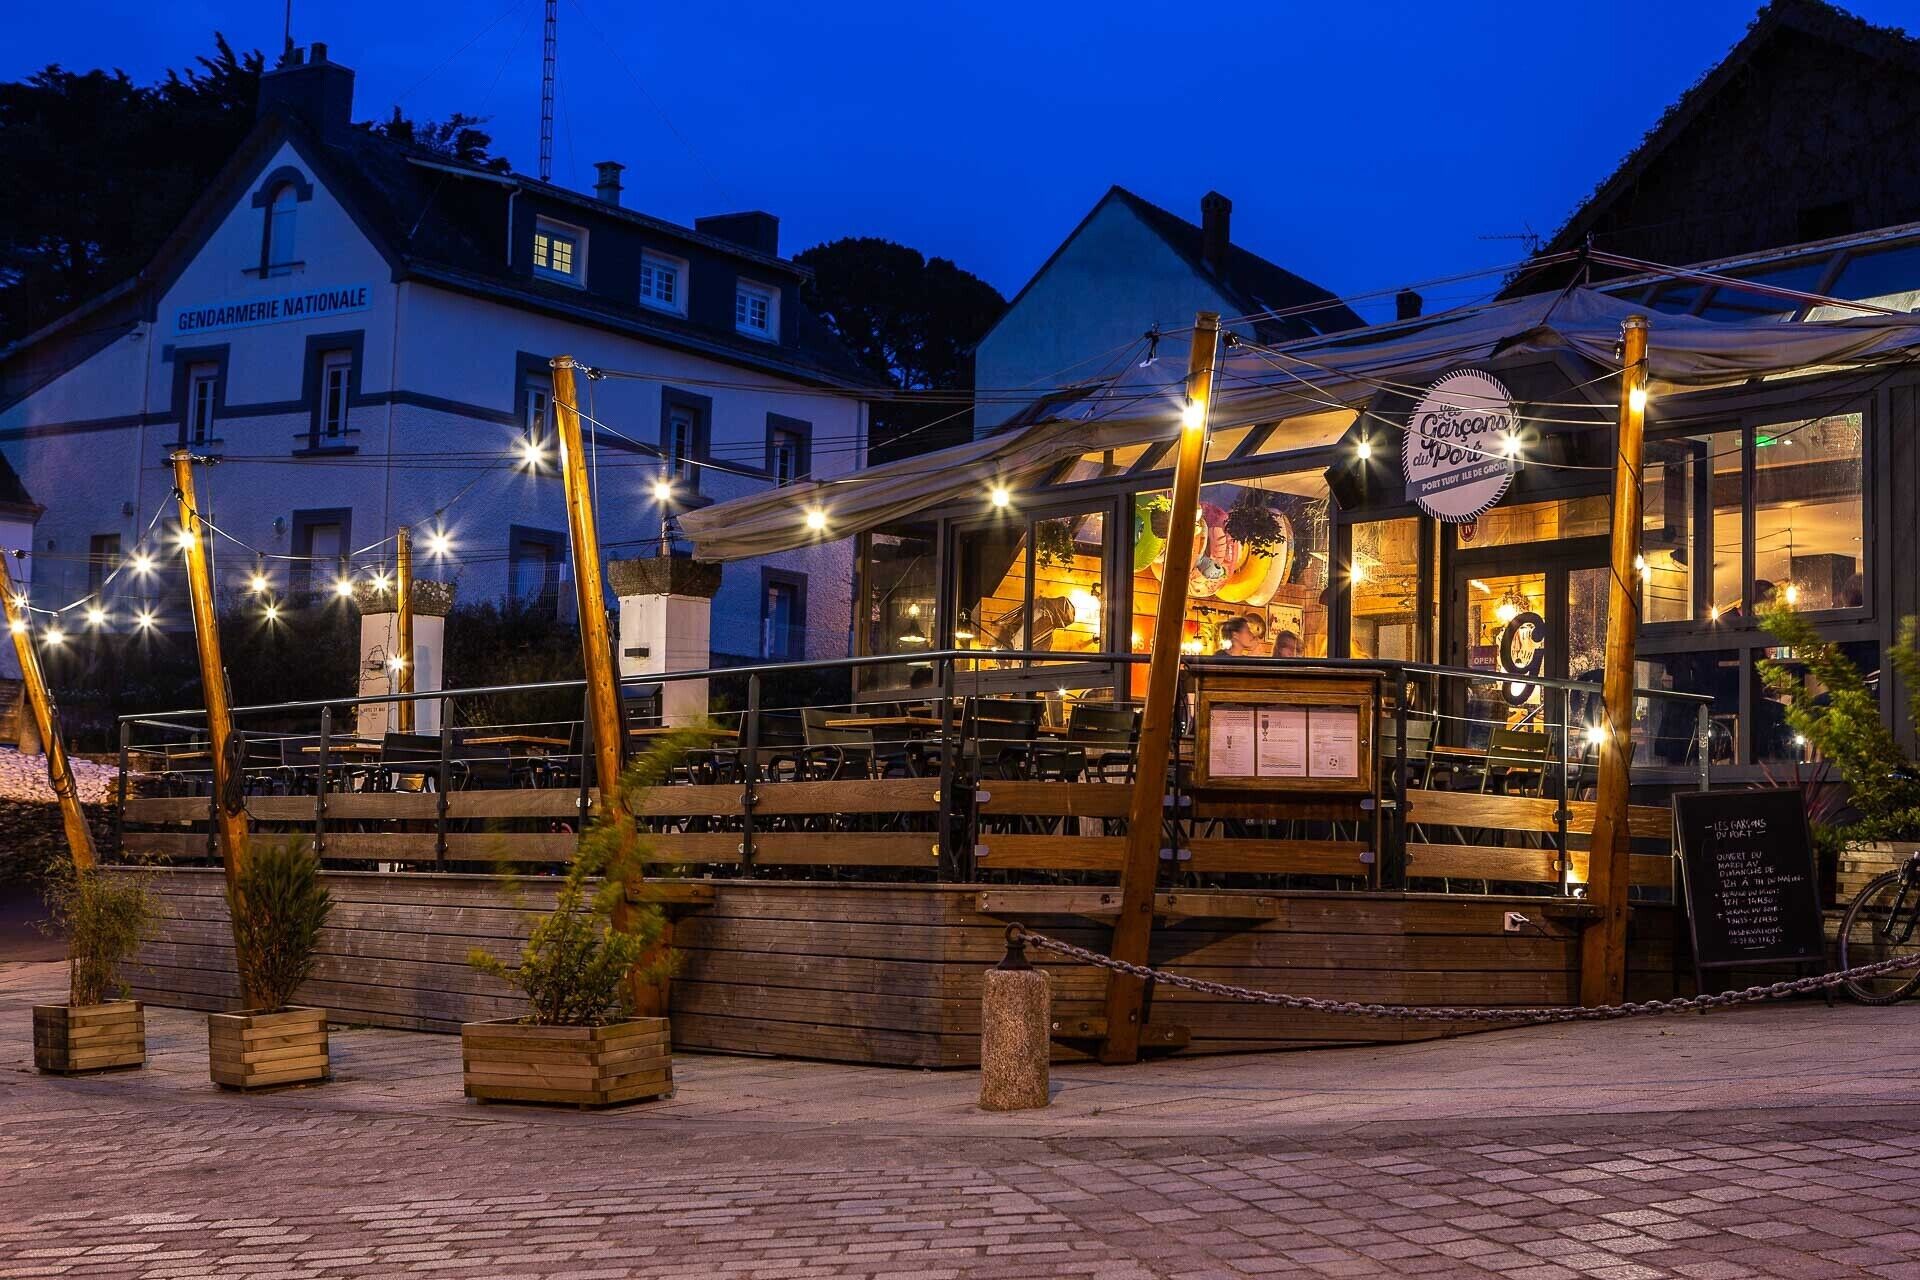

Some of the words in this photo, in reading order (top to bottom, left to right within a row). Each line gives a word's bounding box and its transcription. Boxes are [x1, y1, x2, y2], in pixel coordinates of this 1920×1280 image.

[178, 300, 279, 331] GENDARMERIE
[283, 287, 367, 317] NATIONALE
[1420, 411, 1511, 450] Garçons
[1412, 452, 1431, 467] du
[1429, 440, 1483, 468] Port
[1421, 480, 1441, 491] PORT
[1440, 474, 1460, 487] TUDY
[1462, 470, 1473, 480] ILE
[1473, 467, 1483, 476] DE
[1483, 461, 1508, 474] GROIX
[1474, 656, 1495, 665] OPEN
[1714, 820, 1729, 831] LES
[1716, 831, 1727, 841] DU
[1729, 830, 1752, 838] PORT
[1716, 852, 1745, 861] OUVERT
[1751, 851, 1762, 859] DU
